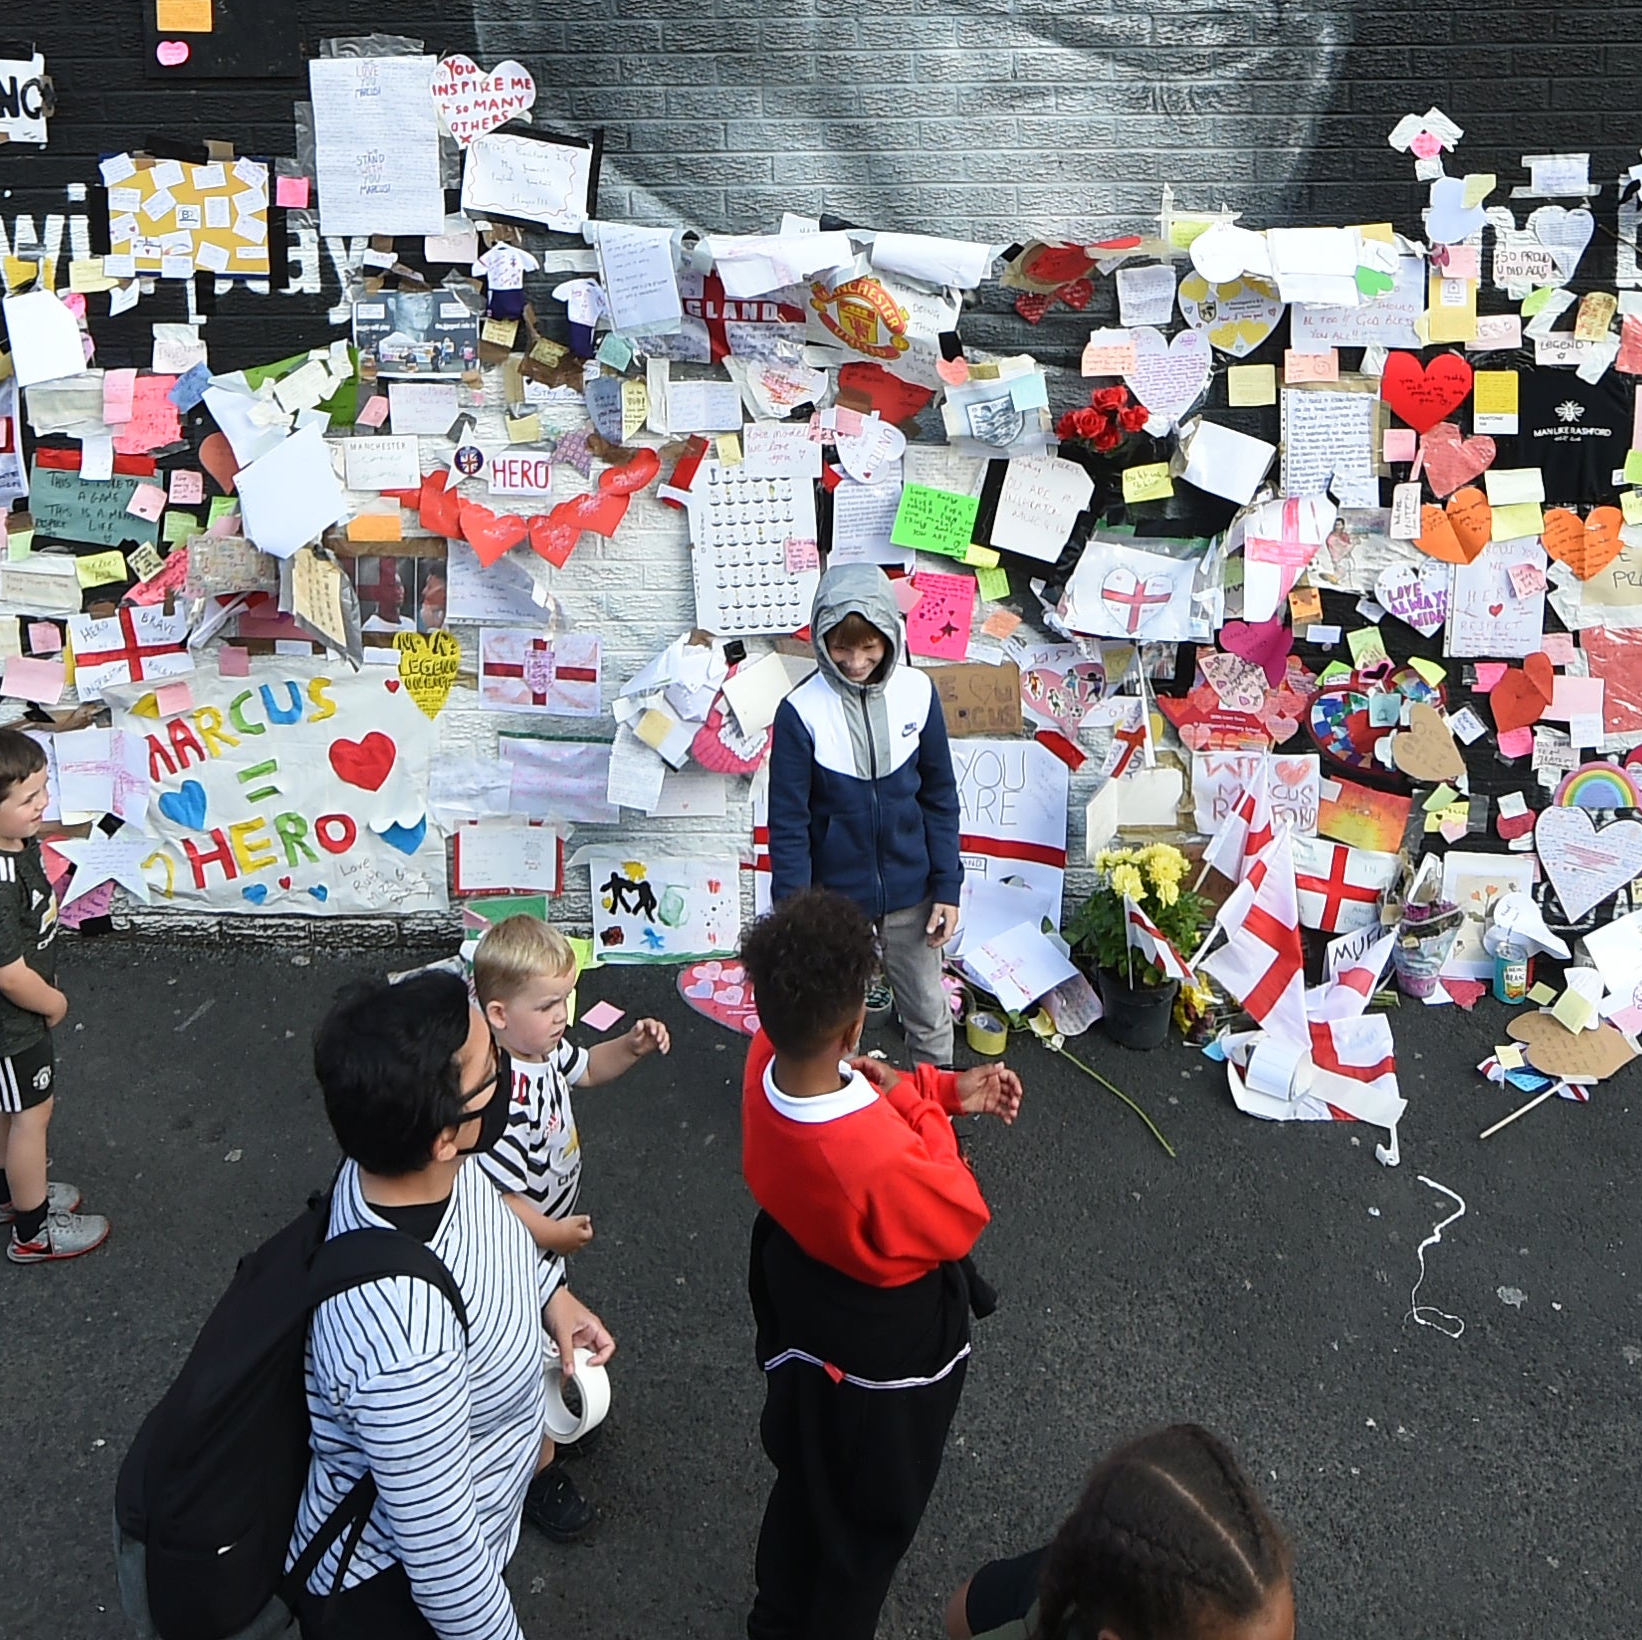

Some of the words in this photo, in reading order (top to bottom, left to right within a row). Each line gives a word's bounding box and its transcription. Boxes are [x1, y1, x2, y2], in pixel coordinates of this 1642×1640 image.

[444, 58, 477, 78] You
[432, 77, 505, 97] INSPIRE
[510, 77, 533, 91] ME
[455, 104, 470, 116] so
[473, 95, 525, 111] MANY
[450, 110, 509, 134] OTHERS
[1502, 252, 1516, 264] SO
[1507, 264, 1524, 276] DID
[1540, 340, 1584, 351] LEGEND
[1570, 426, 1612, 438] RASHFORD
[349, 441, 406, 451] MANCHESTER
[46, 471, 71, 488] THIS
[492, 459, 550, 489] HERO
[78, 492, 86, 501] A
[90, 491, 119, 502] GAME
[45, 503, 73, 517] THIS
[82, 507, 92, 516] IS
[98, 509, 107, 518] A
[1387, 582, 1421, 601] LOVE
[80, 620, 110, 643] HERO
[140, 610, 177, 637] BRAVE
[956, 748, 1026, 791] YOU
[957, 789, 1021, 826] ARE
[1212, 797, 1318, 832] RFORD
[179, 810, 358, 890] HERO
